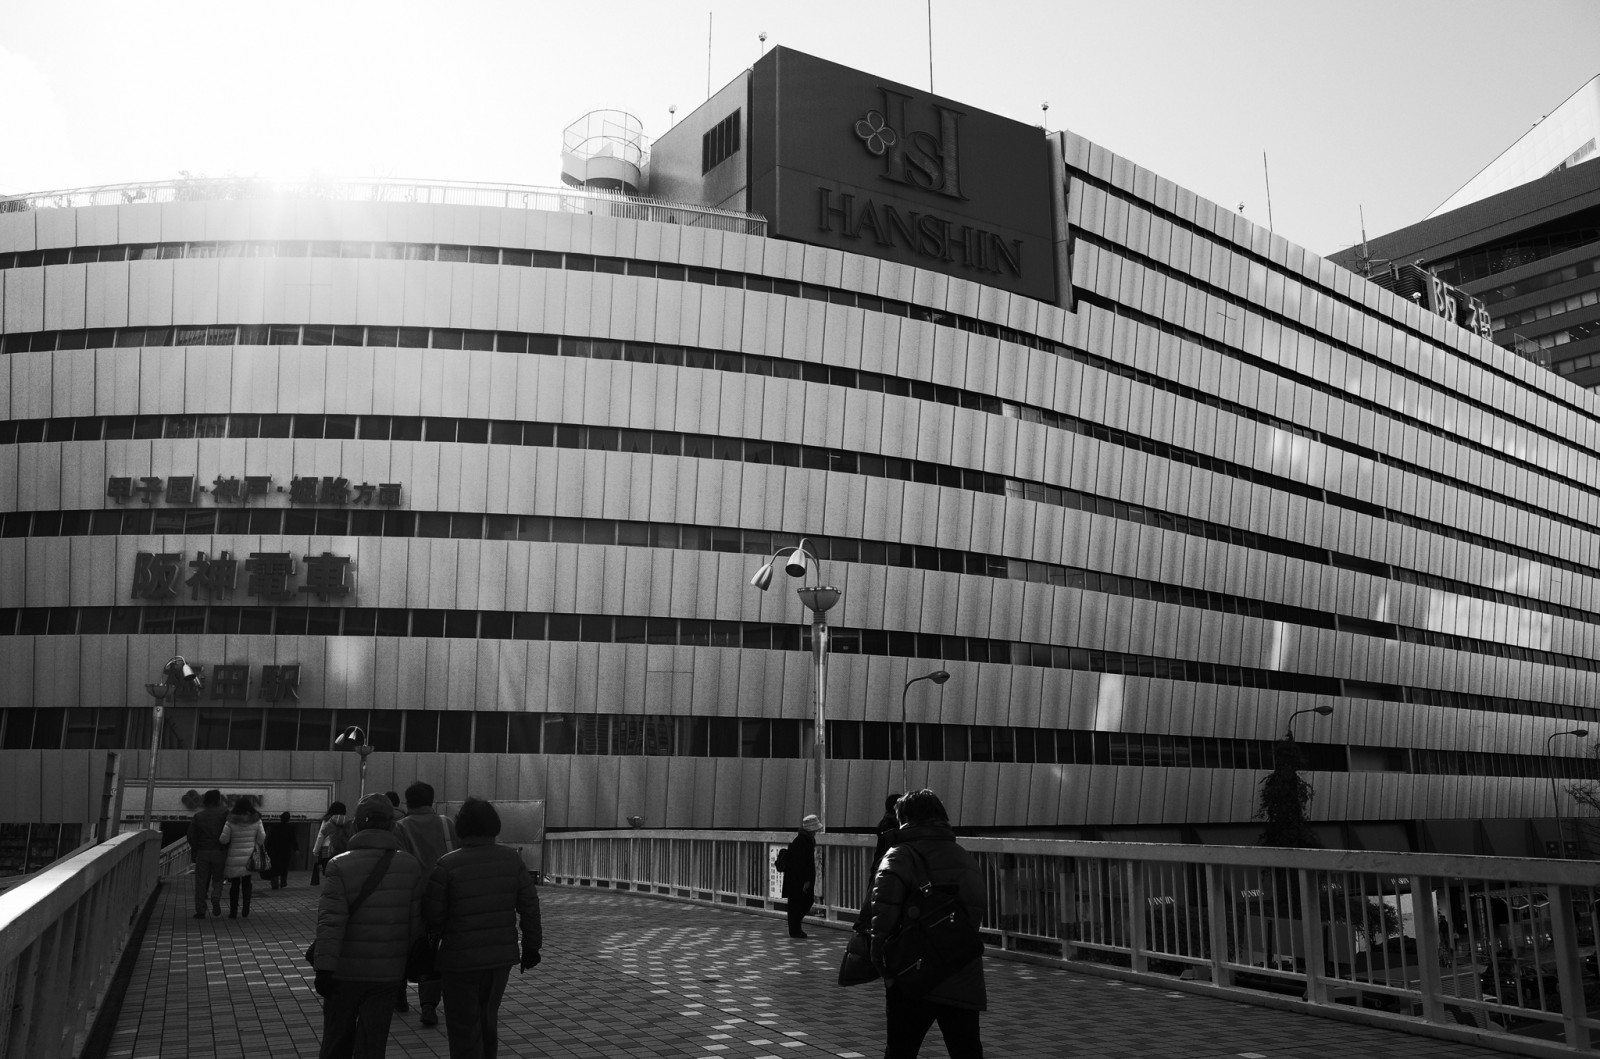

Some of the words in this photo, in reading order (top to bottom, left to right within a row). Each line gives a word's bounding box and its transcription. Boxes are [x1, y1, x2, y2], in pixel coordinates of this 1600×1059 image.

[818, 186, 1023, 279] HANSHIN
[1432, 276, 1493, 341] 阪神
[131, 551, 355, 602] 阪神電車
